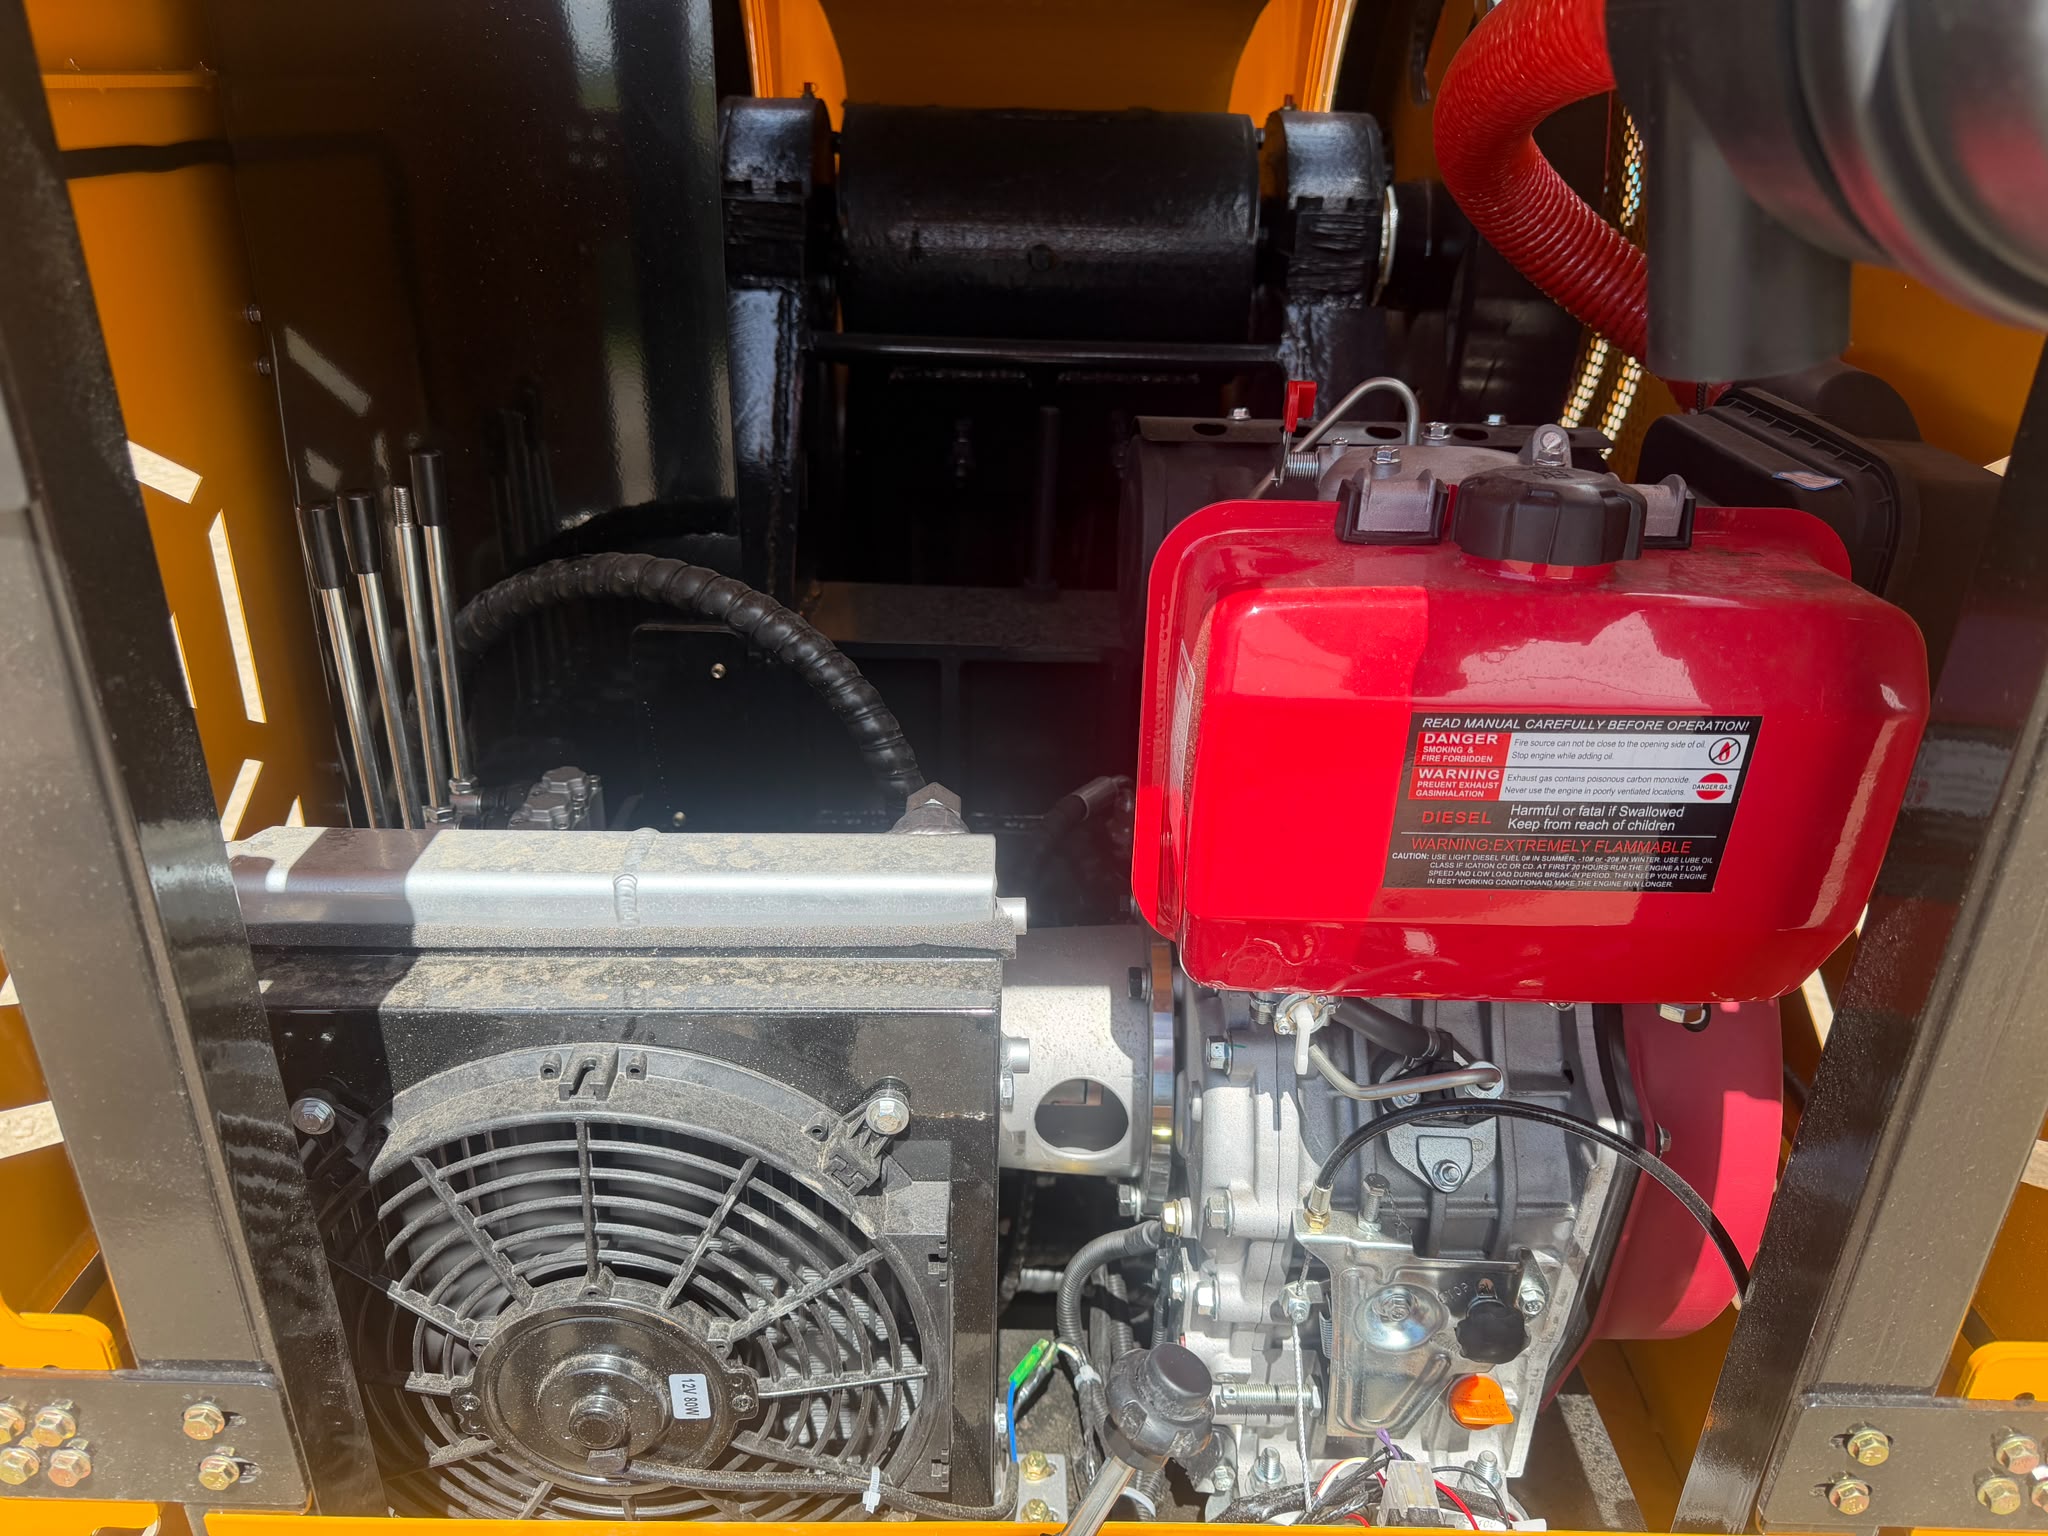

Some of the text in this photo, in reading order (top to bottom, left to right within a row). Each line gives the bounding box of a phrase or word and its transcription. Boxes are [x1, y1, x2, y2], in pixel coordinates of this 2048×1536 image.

[1422, 718, 1750, 732] READ MANUAL CAREFULLY BEFORE OPERATION!
[1424, 734, 1498, 745] DANGER
[1586, 739, 1595, 747] be
[1640, 741, 1668, 749] opening
[1512, 752, 1528, 760] Stop
[1530, 752, 1555, 761] engine
[1577, 752, 1602, 761] adding
[1418, 769, 1500, 780] WARNING
[1558, 787, 1582, 796] engine
[1593, 788, 1615, 796] poorly
[1422, 811, 1492, 824] DIESEL
[1511, 804, 1685, 818] Harmful or fatal if Swallowed
[1507, 818, 1675, 831] Keep from reach of children
[1411, 837, 1692, 853] WARNING:EXTREMELY FLAMMABLE
[682, 1378, 700, 1416] 12V 80W
